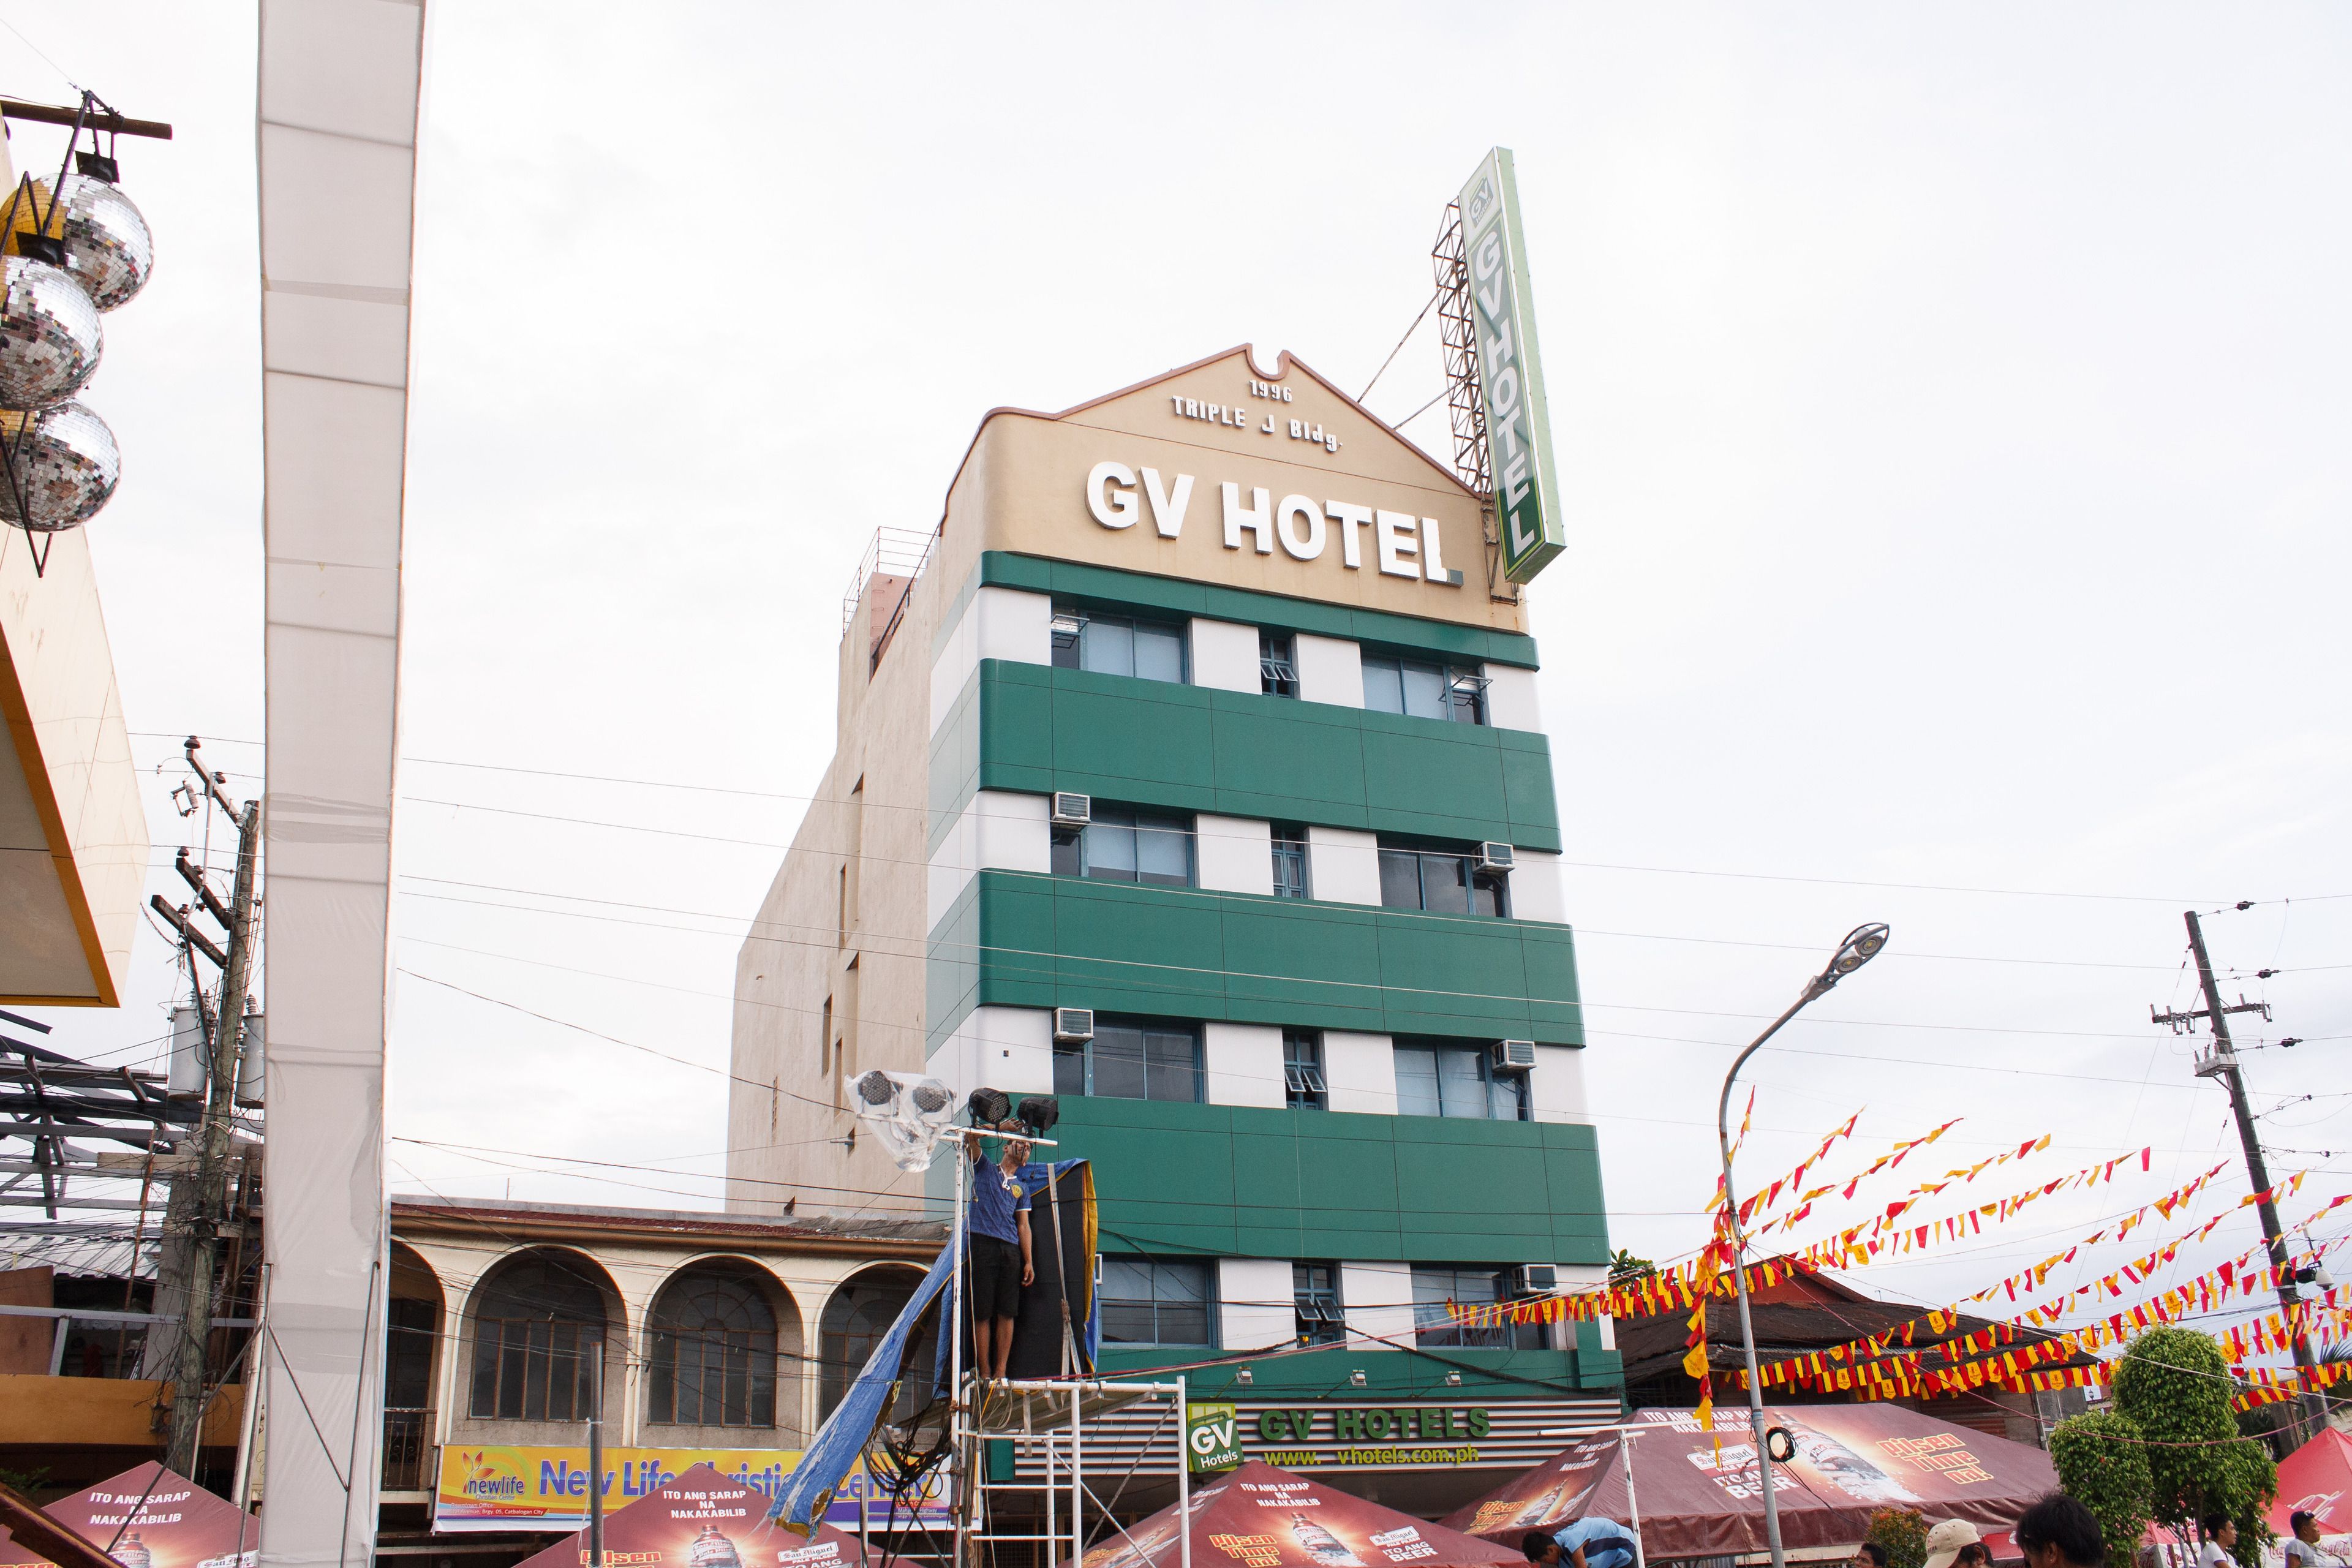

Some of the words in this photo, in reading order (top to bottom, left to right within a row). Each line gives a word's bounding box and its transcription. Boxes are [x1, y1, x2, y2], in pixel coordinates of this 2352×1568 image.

[1471, 179, 1488, 219] GV
[1249, 380, 1292, 402] 1996
[1172, 395, 1246, 428] TRIPLE
[1262, 415, 1275, 434] J
[1290, 418, 1343, 452] Bldg.
[1487, 317, 1535, 559] HOTEL
[1085, 461, 1195, 540] GV
[1220, 481, 1464, 588] HOTEL
[1261, 1410, 1315, 1439] GV
[1336, 1408, 1490, 1439] HOTELS
[1643, 1412, 1667, 1422] ITO
[1191, 1419, 1234, 1454] GV
[1875, 1433, 1966, 1457] Pilsen
[1200, 1450, 1238, 1468] Hotels
[1901, 1451, 1980, 1472] Time
[469, 1476, 525, 1494] newlife
[539, 1460, 616, 1497] New
[1279, 1482, 1310, 1491] SARAP
[1713, 1474, 1741, 1487] ITO
[90, 1492, 112, 1502] ITO
[146, 1491, 190, 1504] SARAP
[663, 1490, 681, 1499] ITO
[684, 1491, 707, 1500] ANG
[709, 1490, 746, 1499] SARAP
[90, 1513, 182, 1525] NAKAKABILIB
[671, 1509, 747, 1518] NAKAKABILIB
[1209, 1533, 1277, 1548] Pilsen
[1405, 1541, 1430, 1551] ANG
[580, 1550, 662, 1564] Plsen
[1221, 1545, 1280, 1558] Time
[1389, 1547, 1438, 1562] BEER
